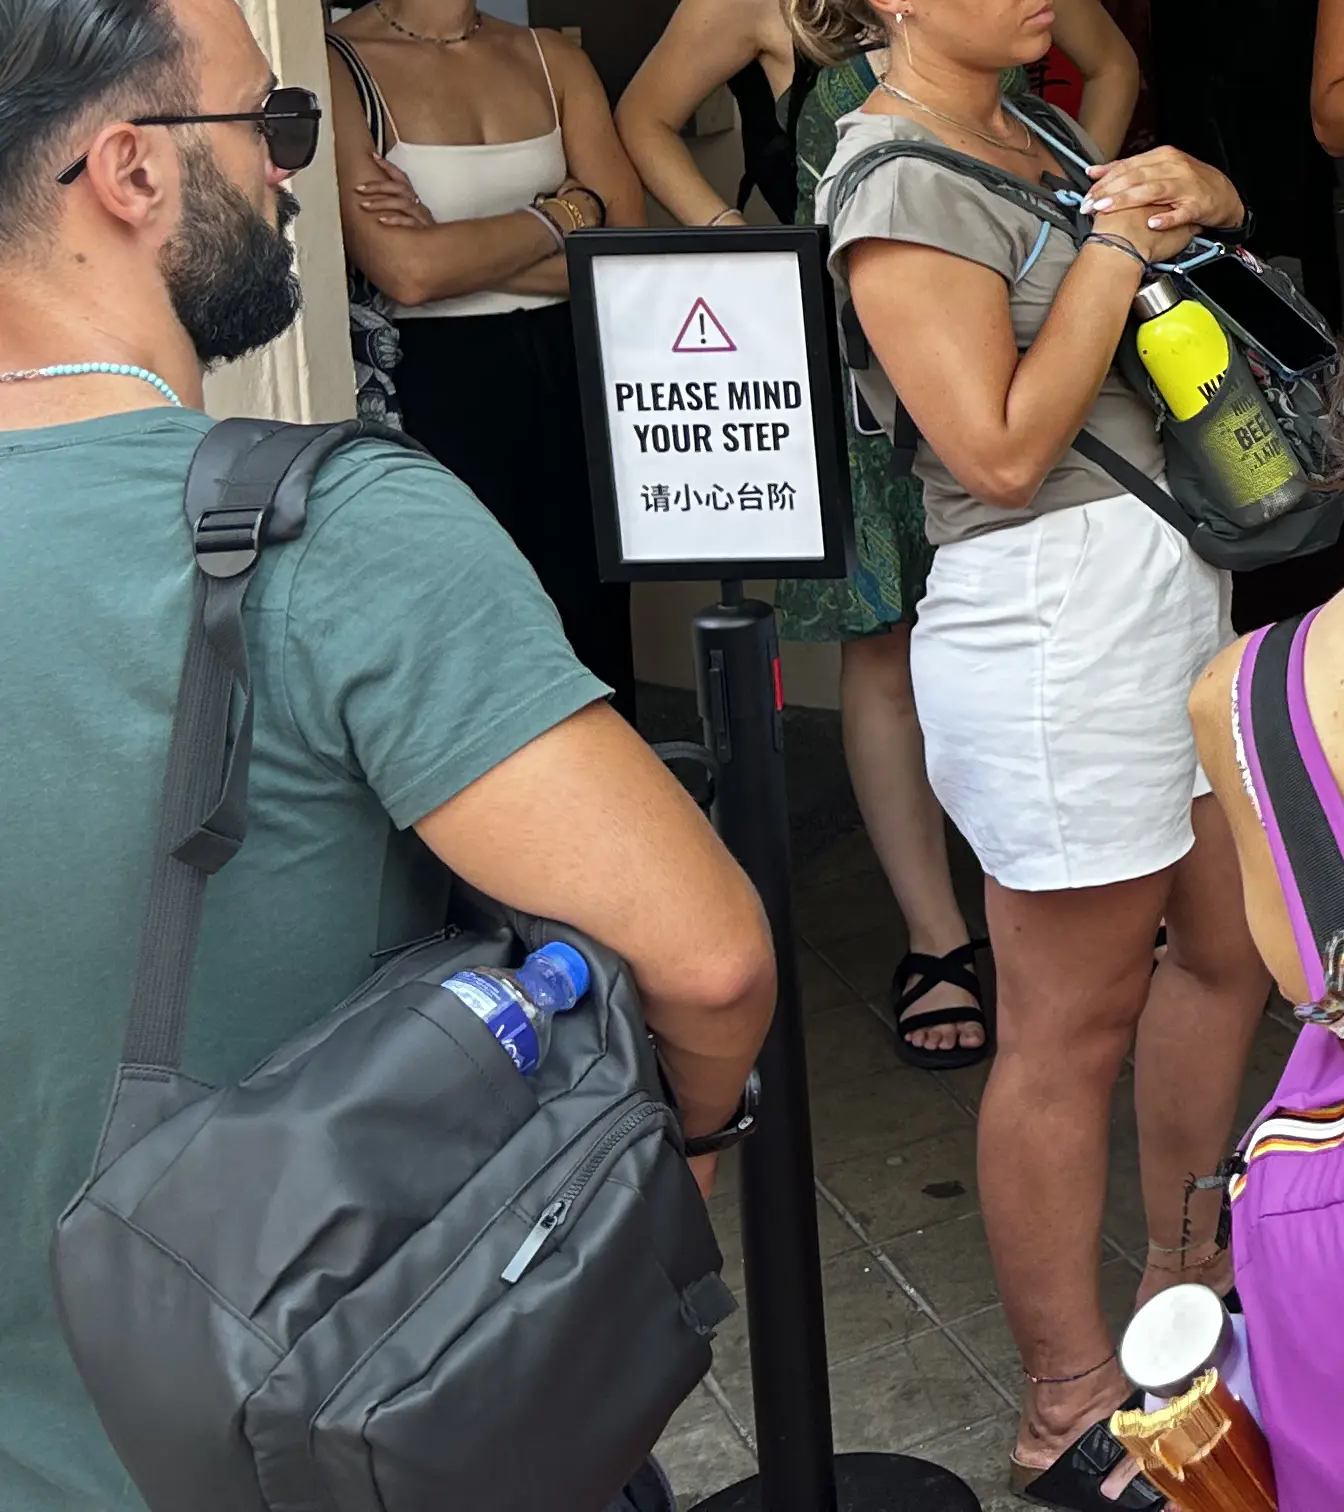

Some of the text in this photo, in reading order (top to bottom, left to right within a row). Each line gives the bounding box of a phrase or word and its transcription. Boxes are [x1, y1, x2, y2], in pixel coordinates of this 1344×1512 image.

[615, 379, 802, 413] PLEASE MIND
[632, 421, 790, 454] YOUR STEP
[640, 481, 798, 514] 请小心台阶
